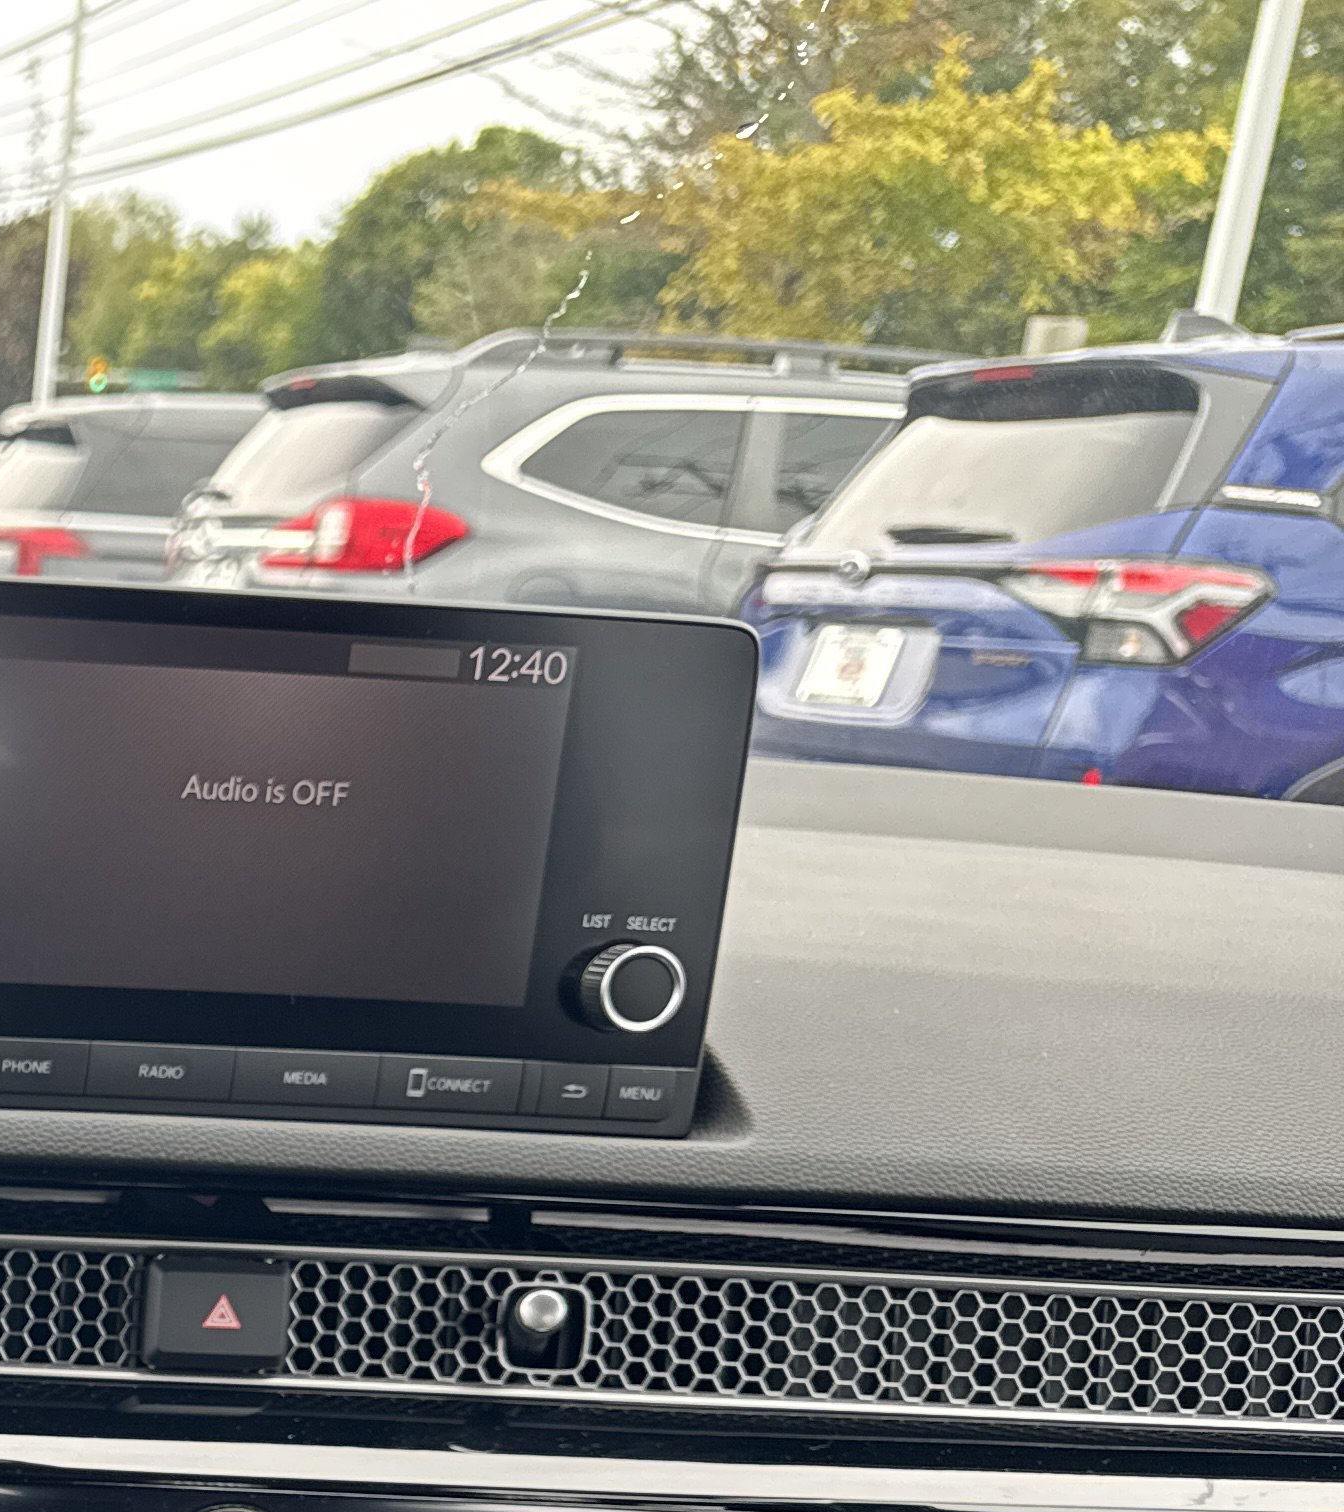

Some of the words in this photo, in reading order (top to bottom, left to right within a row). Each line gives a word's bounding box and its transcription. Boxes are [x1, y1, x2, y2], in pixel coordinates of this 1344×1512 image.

[468, 647, 568, 686] 12:40
[180, 774, 259, 804] Audio
[264, 778, 286, 805] is
[291, 780, 350, 808] OFF
[582, 914, 612, 929] LIST
[626, 916, 677, 932] SELECT
[1, 1058, 52, 1075] PHONE
[138, 1063, 186, 1081] RADIO
[283, 1070, 328, 1087] MEDIA
[427, 1076, 493, 1094] CONNECT
[618, 1085, 663, 1102] MENU
